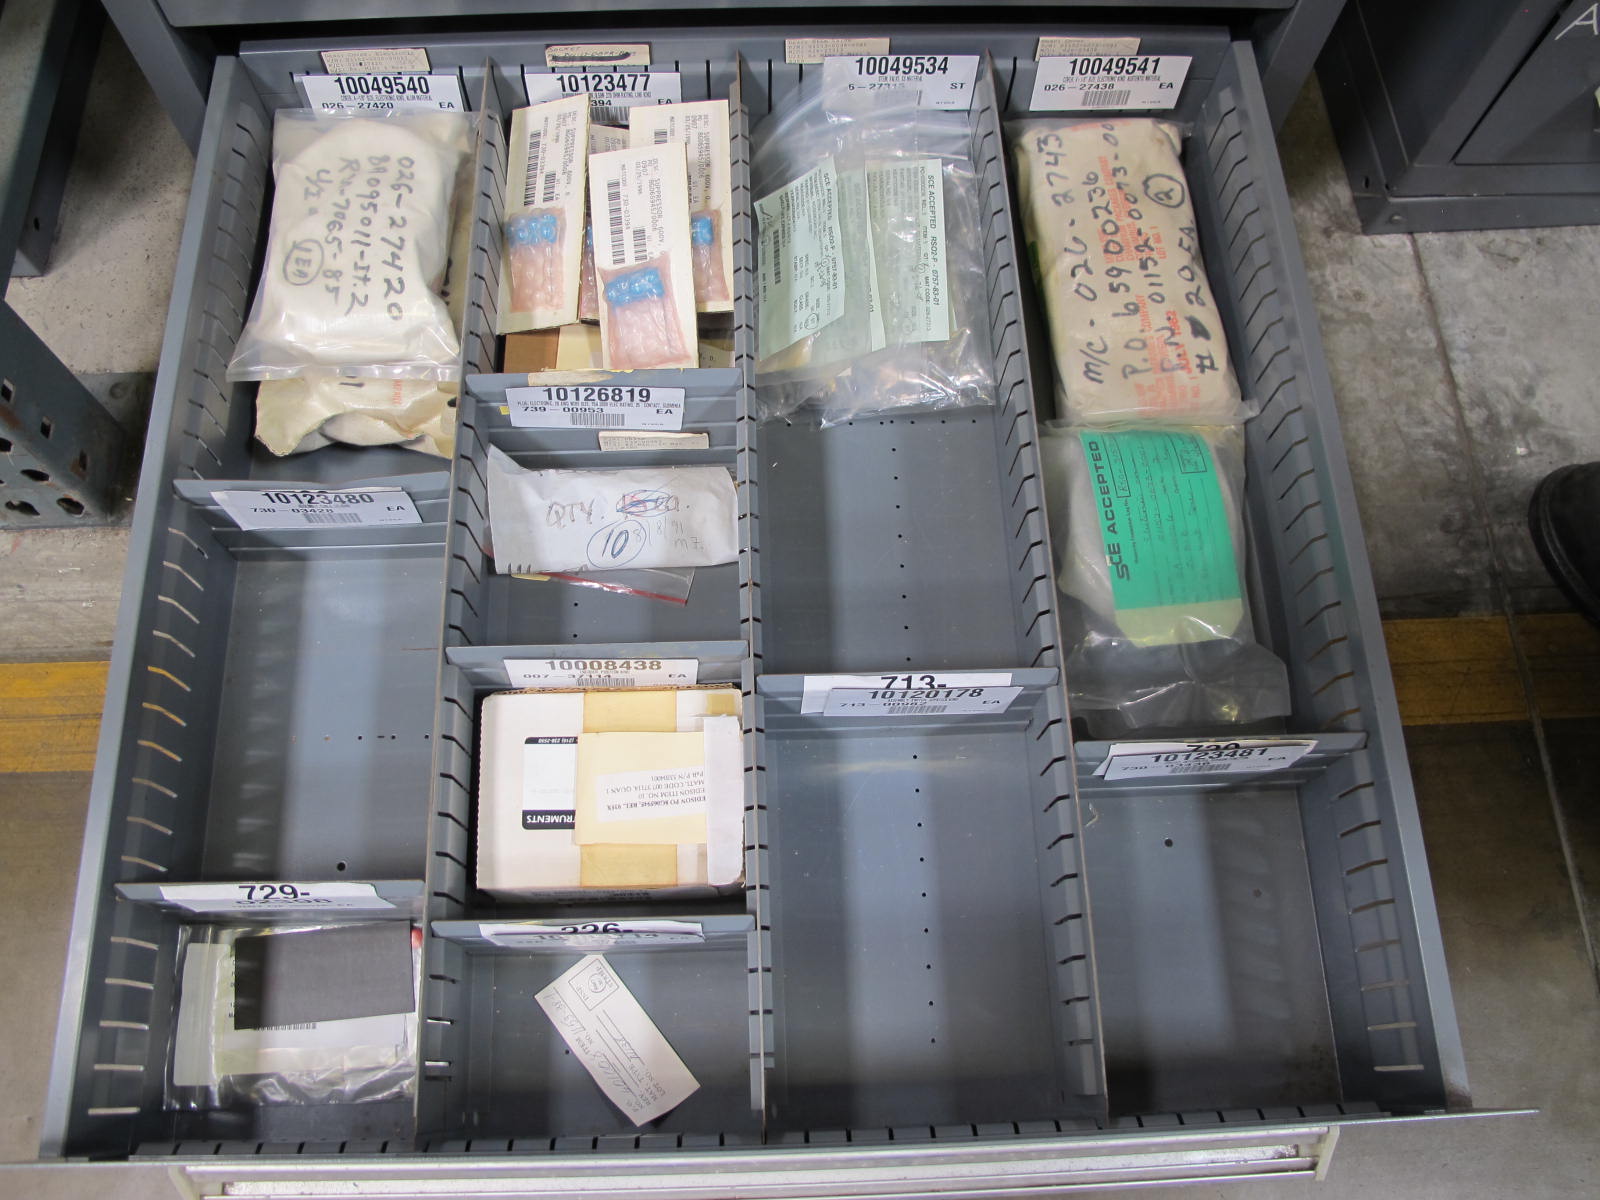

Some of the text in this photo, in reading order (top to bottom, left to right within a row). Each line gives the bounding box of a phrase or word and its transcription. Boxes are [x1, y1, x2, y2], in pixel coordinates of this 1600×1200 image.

[855, 56, 949, 76] 10049534
[1069, 57, 1161, 76] 10049541
[334, 76, 430, 95] 10049540
[556, 74, 651, 93] 10123477
[950, 82, 966, 90] ST
[1158, 82, 1174, 90] EA
[927, 175, 935, 189] SCE
[1153, 188, 1175, 201] 2
[928, 190, 937, 229] ACCEPTED
[381, 155, 415, 321] 026-27420
[543, 387, 652, 403] 10126819
[262, 492, 375, 505] 10123480
[1088, 440, 1131, 582] SCE ACCEPTED
[601, 529, 630, 559] 10
[545, 660, 662, 671] 10008438
[881, 675, 947, 689] 713-
[868, 688, 984, 700] 10120178
[1151, 748, 1269, 763] 10123481
[664, 781, 684, 790] CODE
[680, 787, 705, 798] EDISON
[660, 790, 680, 799] ITEM
[680, 796, 706, 805] EDISON
[238, 884, 311, 900] 729-
